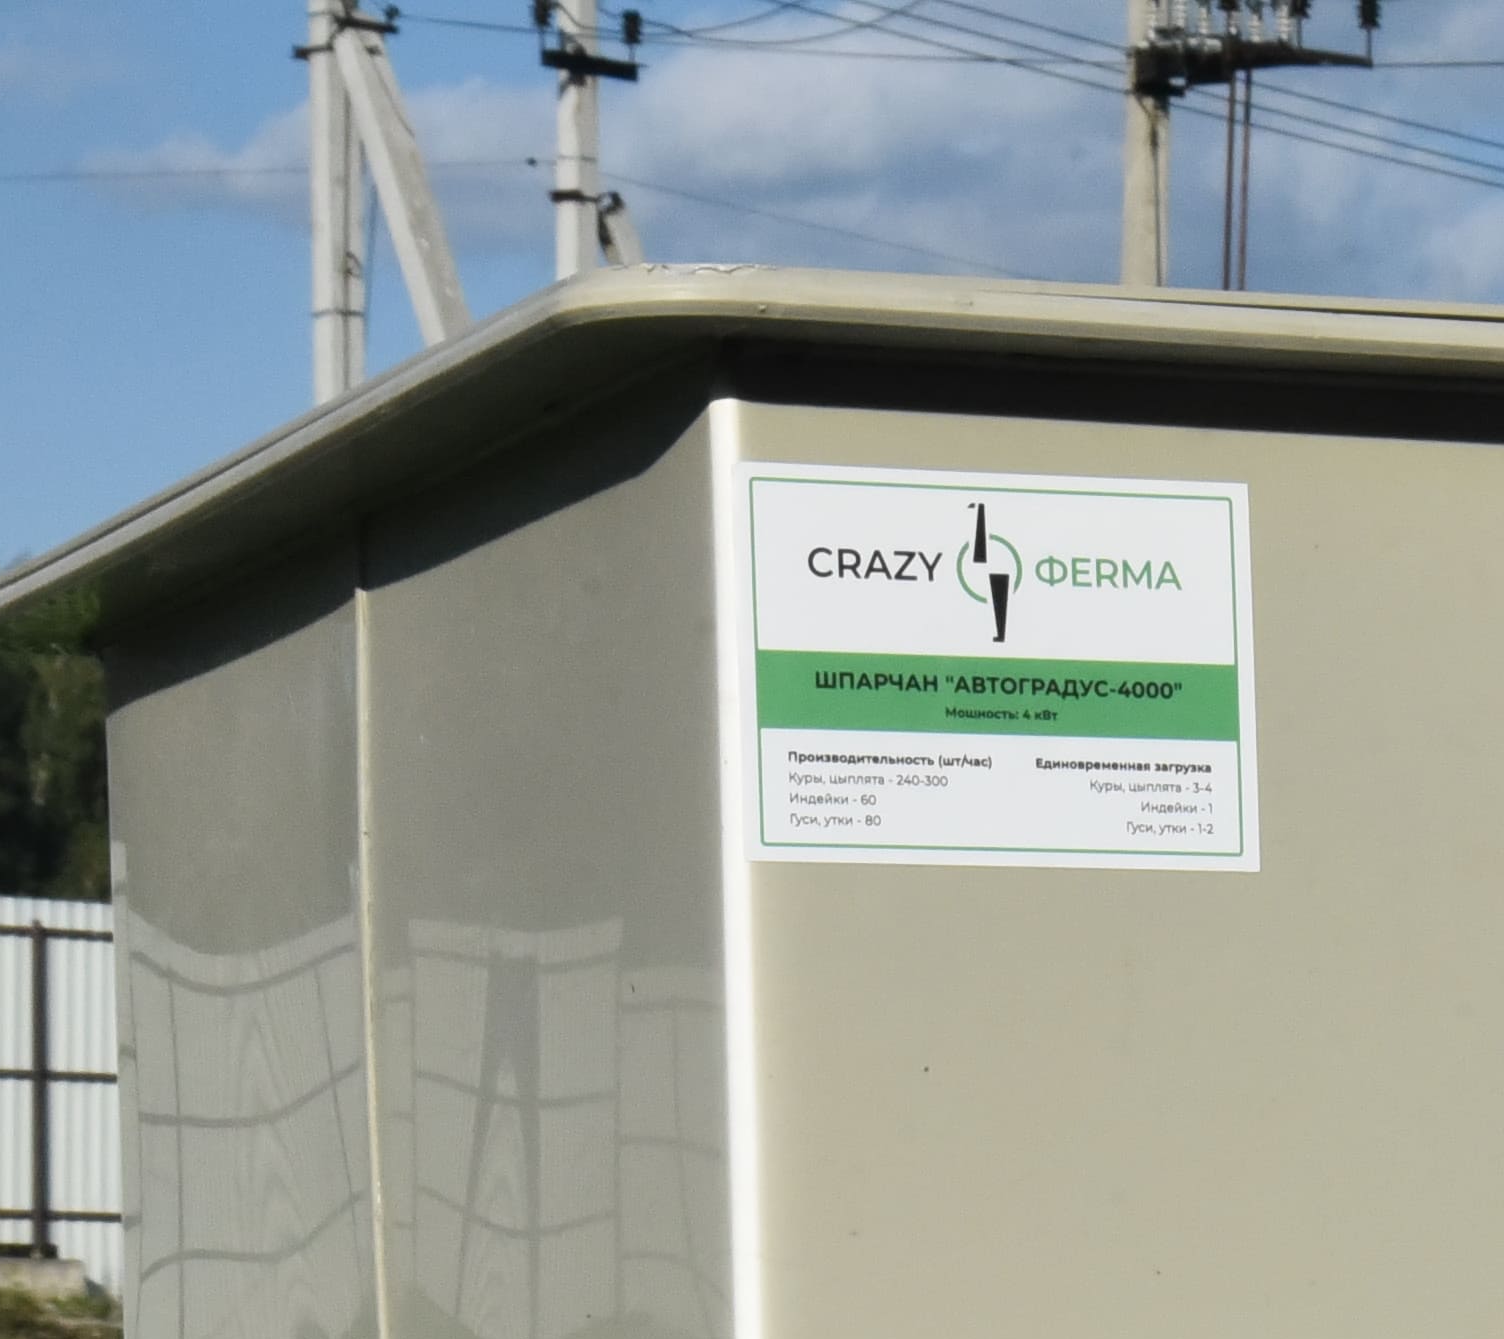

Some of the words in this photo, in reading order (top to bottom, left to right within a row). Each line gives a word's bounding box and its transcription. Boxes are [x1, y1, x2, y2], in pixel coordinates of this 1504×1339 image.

[807, 546, 943, 582] CRAZY
[815, 671, 938, 692] ШПАРЧАН
[946, 675, 1183, 700] "АВТОГРАДУС-4000"
[1022, 710, 1031, 720] 4
[1034, 710, 1058, 721] кВт
[788, 751, 934, 766] Производительность
[938, 754, 992, 769] (шт/час)
[1035, 758, 1151, 772] Единовременная
[1154, 761, 1212, 775] загрузка
[789, 772, 826, 786] Куры,
[829, 774, 885, 786] цыплята
[896, 774, 948, 787] 240-300
[1089, 779, 1125, 794] Куры,
[1129, 781, 1182, 794] цыплята
[1192, 782, 1212, 793] 3-4
[789, 792, 849, 806] Индейки
[860, 794, 877, 806] 60
[1141, 801, 1197, 814] Индейки
[1208, 803, 1214, 814] 1
[790, 813, 821, 827] Гуси,
[823, 815, 853, 827] утки
[865, 815, 882, 826] 80
[1126, 821, 1156, 835] Гуси,
[1158, 824, 1187, 836] утки
[1198, 823, 1214, 835] 1-2
